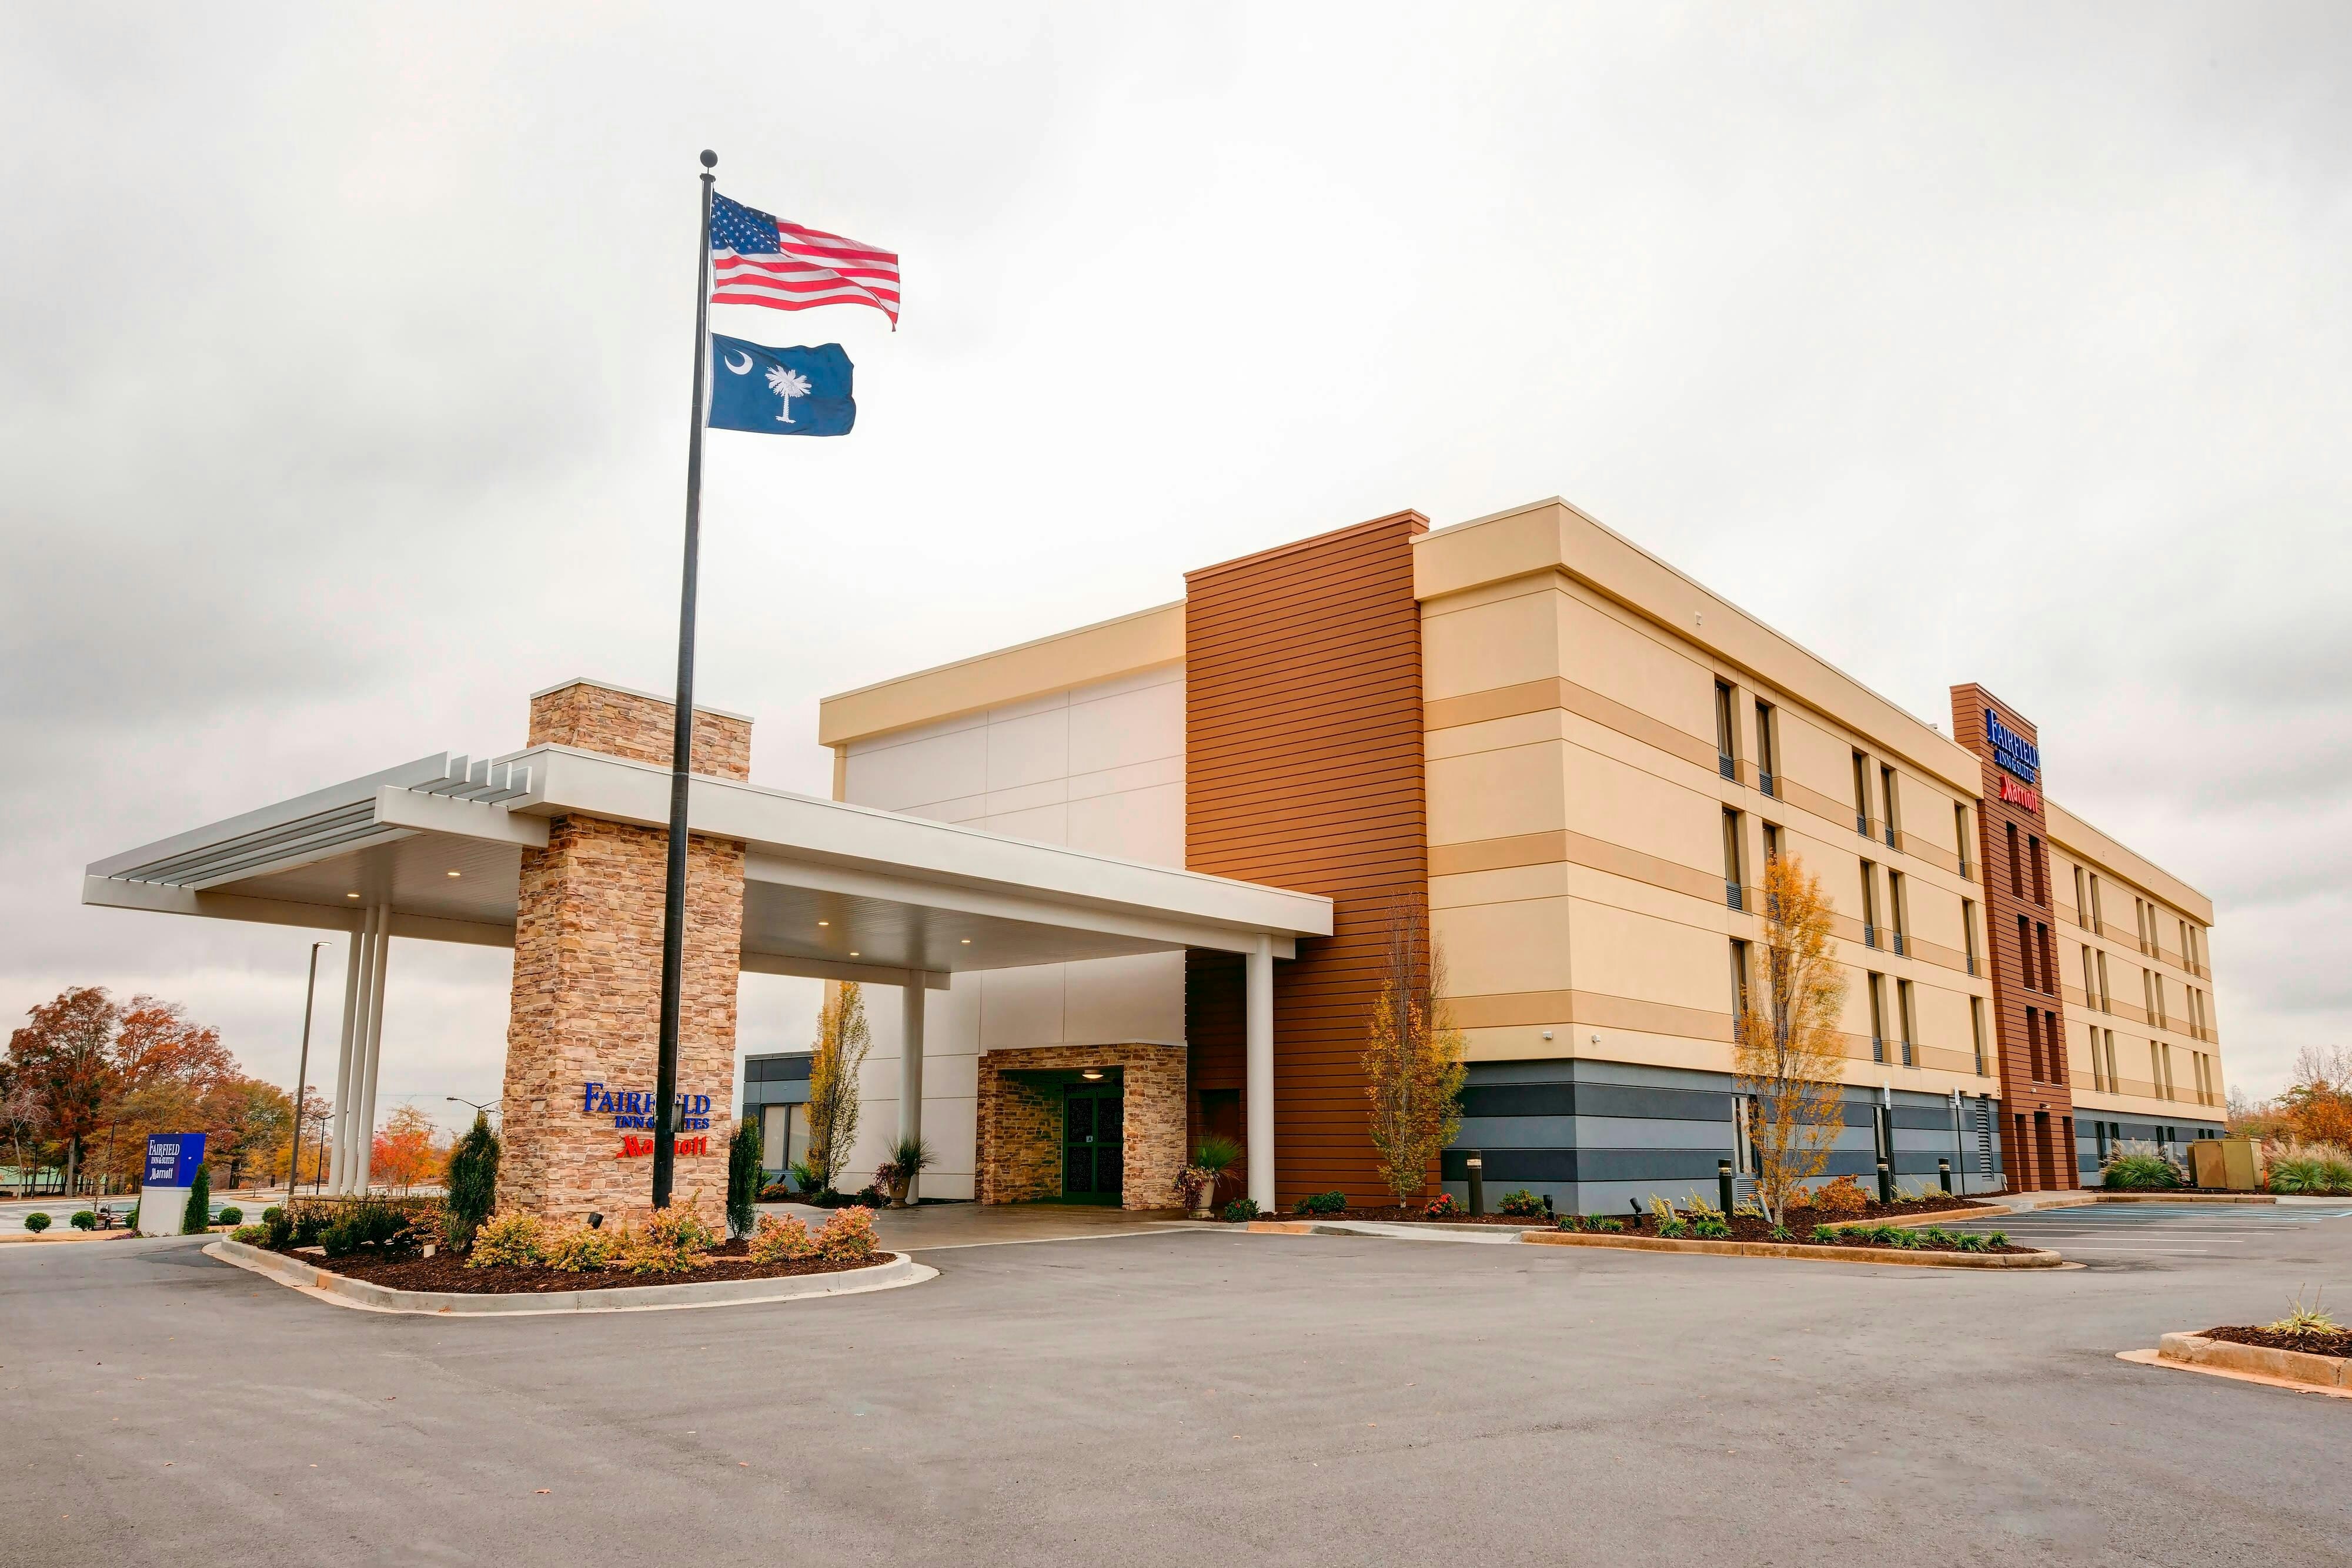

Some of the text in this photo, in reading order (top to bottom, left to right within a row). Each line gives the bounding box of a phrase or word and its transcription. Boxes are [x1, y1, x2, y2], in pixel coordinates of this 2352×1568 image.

[1986, 708, 2039, 768] FAIRFIELD
[1998, 750, 2011, 769] INN
[2017, 761, 2036, 784] SUITES
[2002, 775, 2038, 814] Marriott
[583, 1082, 710, 1115] FAIRFLD
[615, 1116, 644, 1128] INN
[149, 1139, 180, 1156] FAIRFIELD
[617, 1135, 707, 1158] Maiott
[149, 1168, 173, 1181] Marriott
